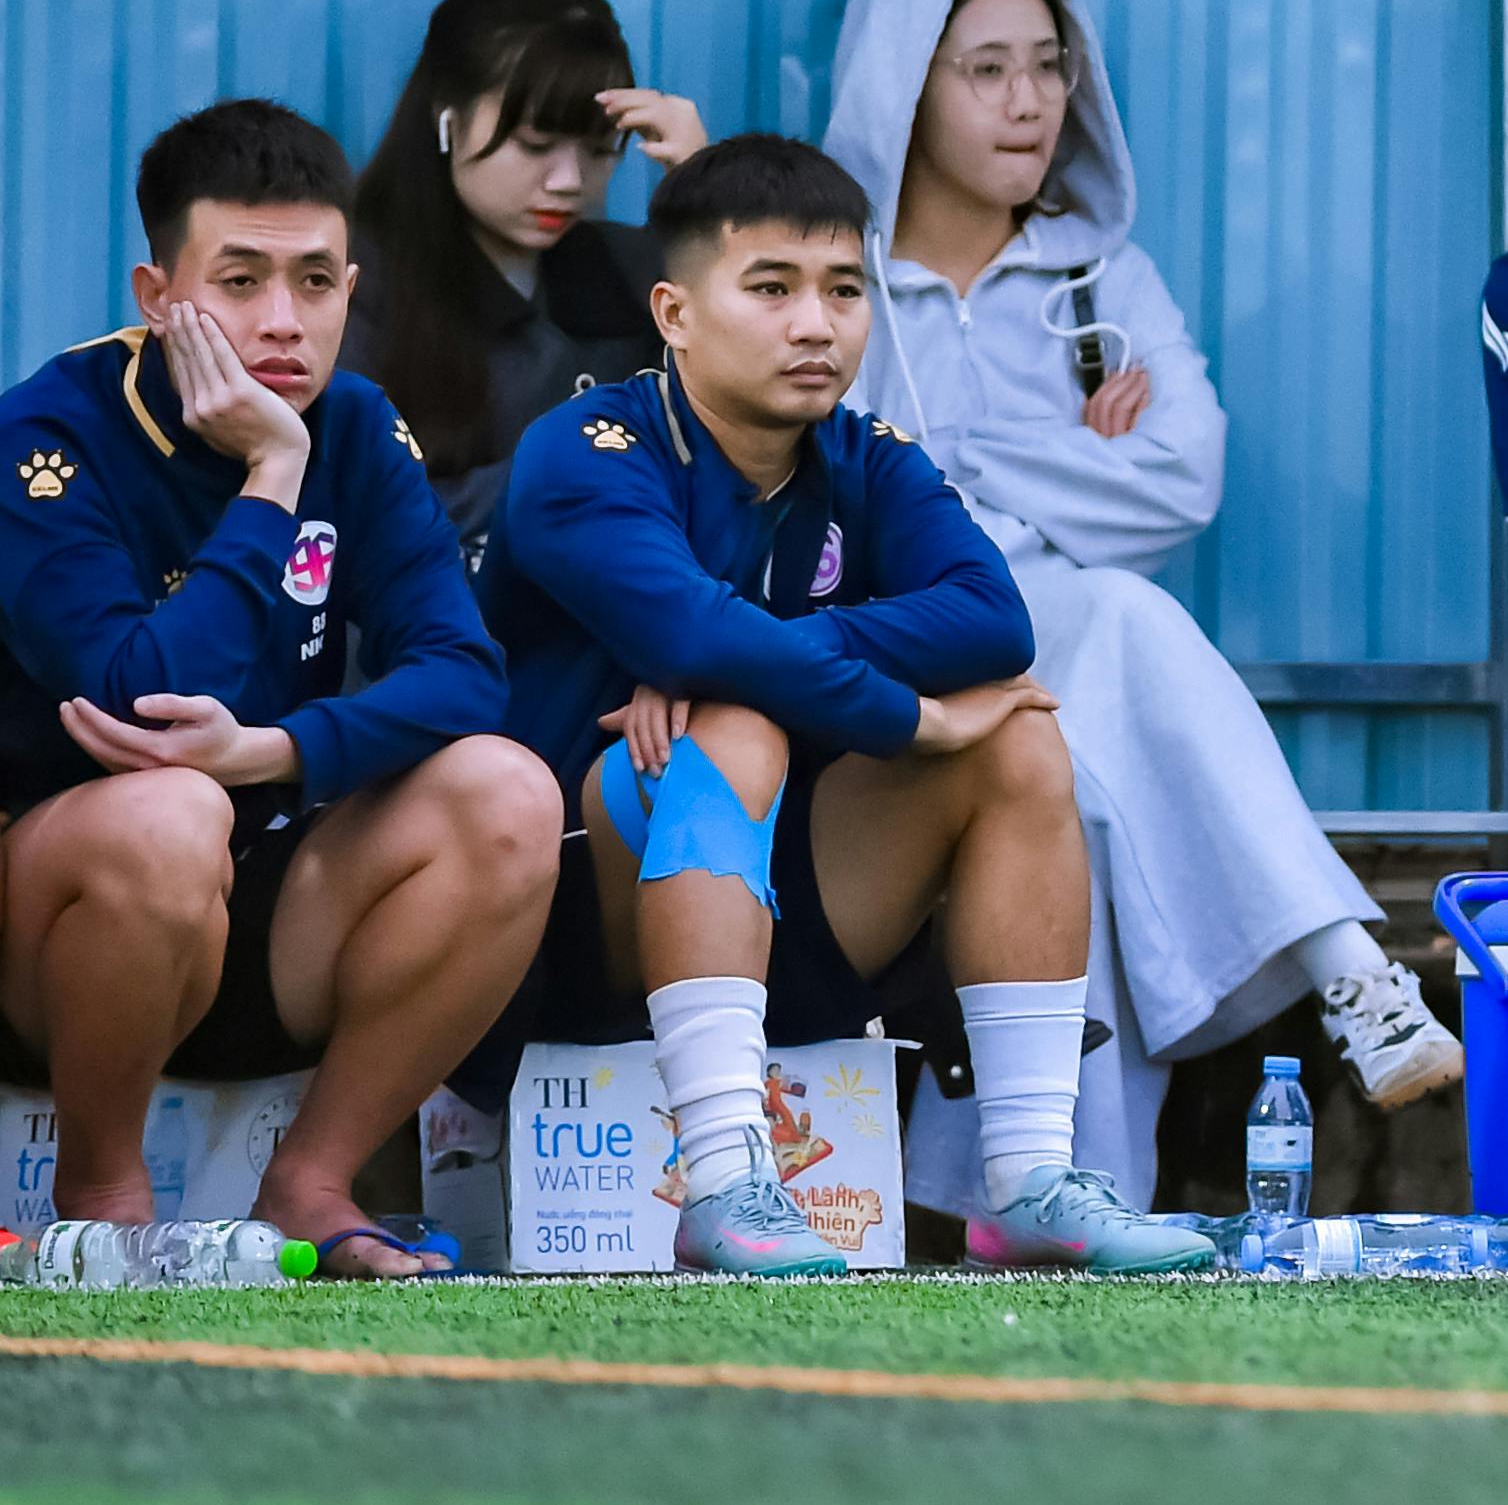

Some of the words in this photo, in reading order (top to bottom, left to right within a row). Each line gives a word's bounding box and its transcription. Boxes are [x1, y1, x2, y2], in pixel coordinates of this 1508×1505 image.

[533, 1076, 590, 1109] TH
[531, 1113, 634, 1160] true
[17, 1147, 56, 1192] tr
[535, 1165, 635, 1192] WATER
[536, 1225, 587, 1254] 350
[597, 1224, 636, 1252] ml
